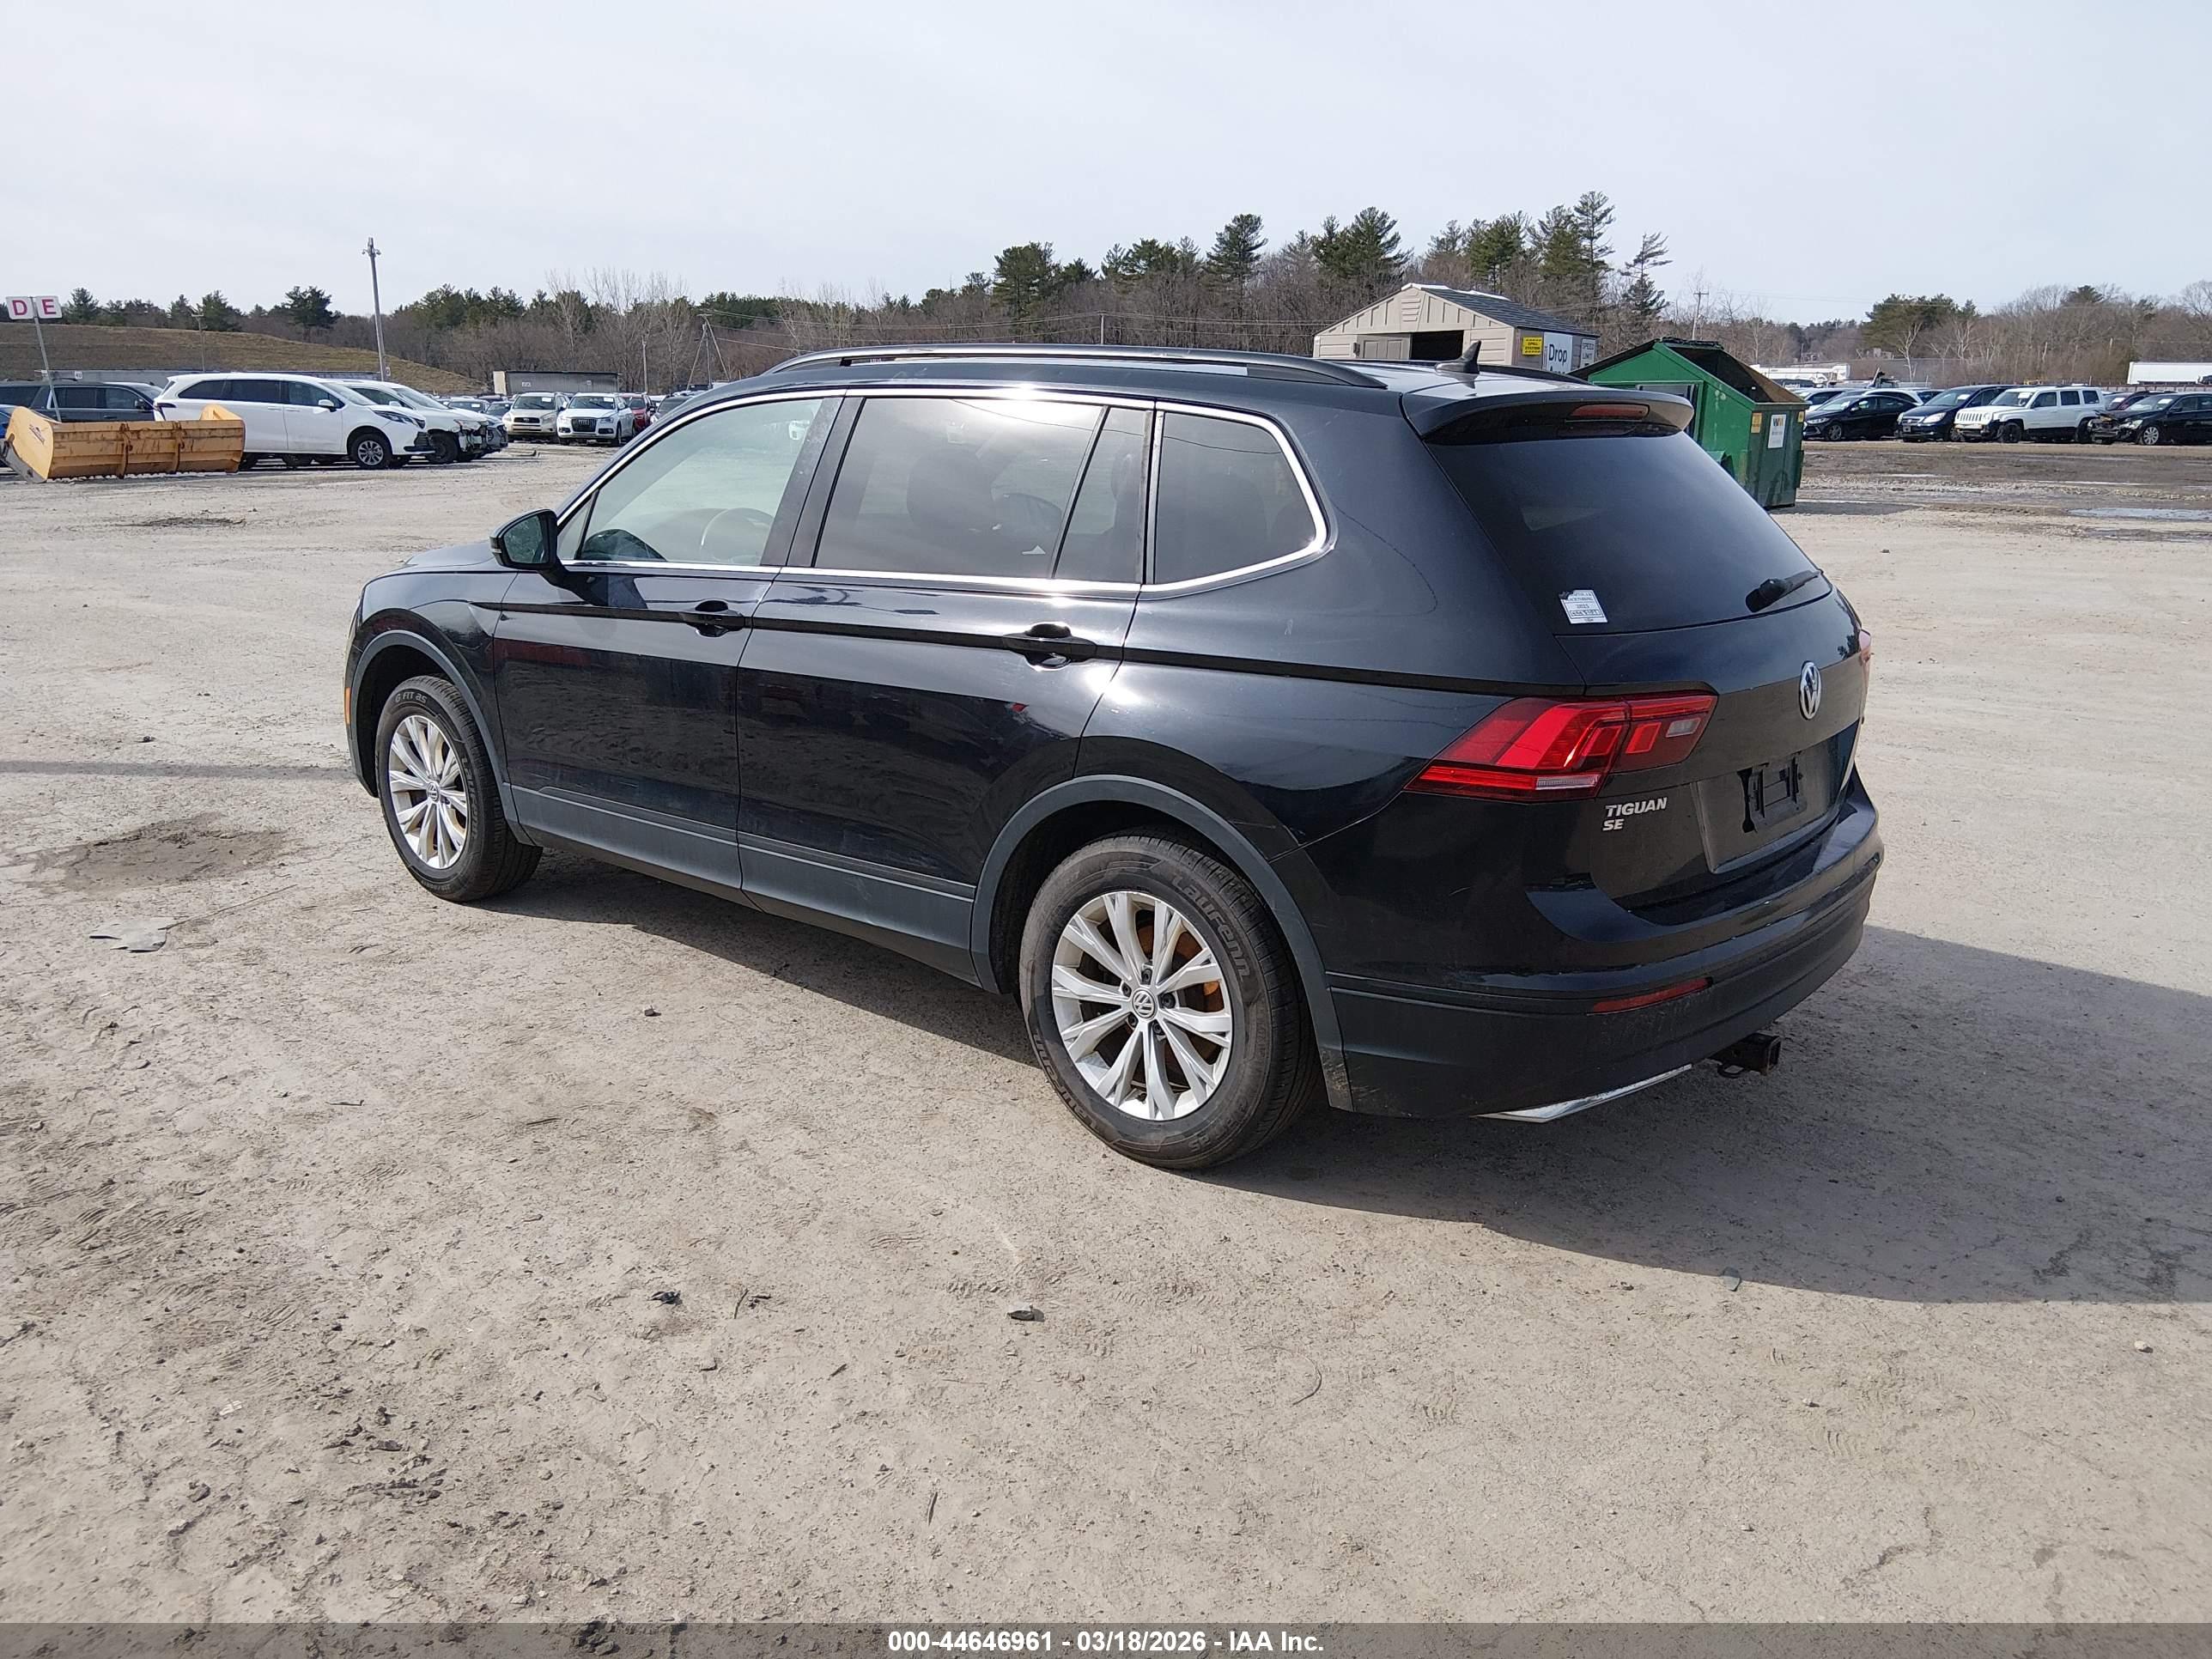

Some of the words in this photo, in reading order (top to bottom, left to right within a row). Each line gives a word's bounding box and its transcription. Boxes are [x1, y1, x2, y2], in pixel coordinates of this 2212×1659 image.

[12, 300, 27, 316] D
[41, 299, 57, 315] E
[1548, 344, 1567, 365] Drop
[1582, 342, 1595, 350] SPEED
[395, 693, 401, 703] G
[403, 691, 415, 700] FIT
[1605, 797, 1668, 817] TIGUAN
[1602, 818, 1625, 831] SE
[1171, 875, 1250, 986] Laufenn
